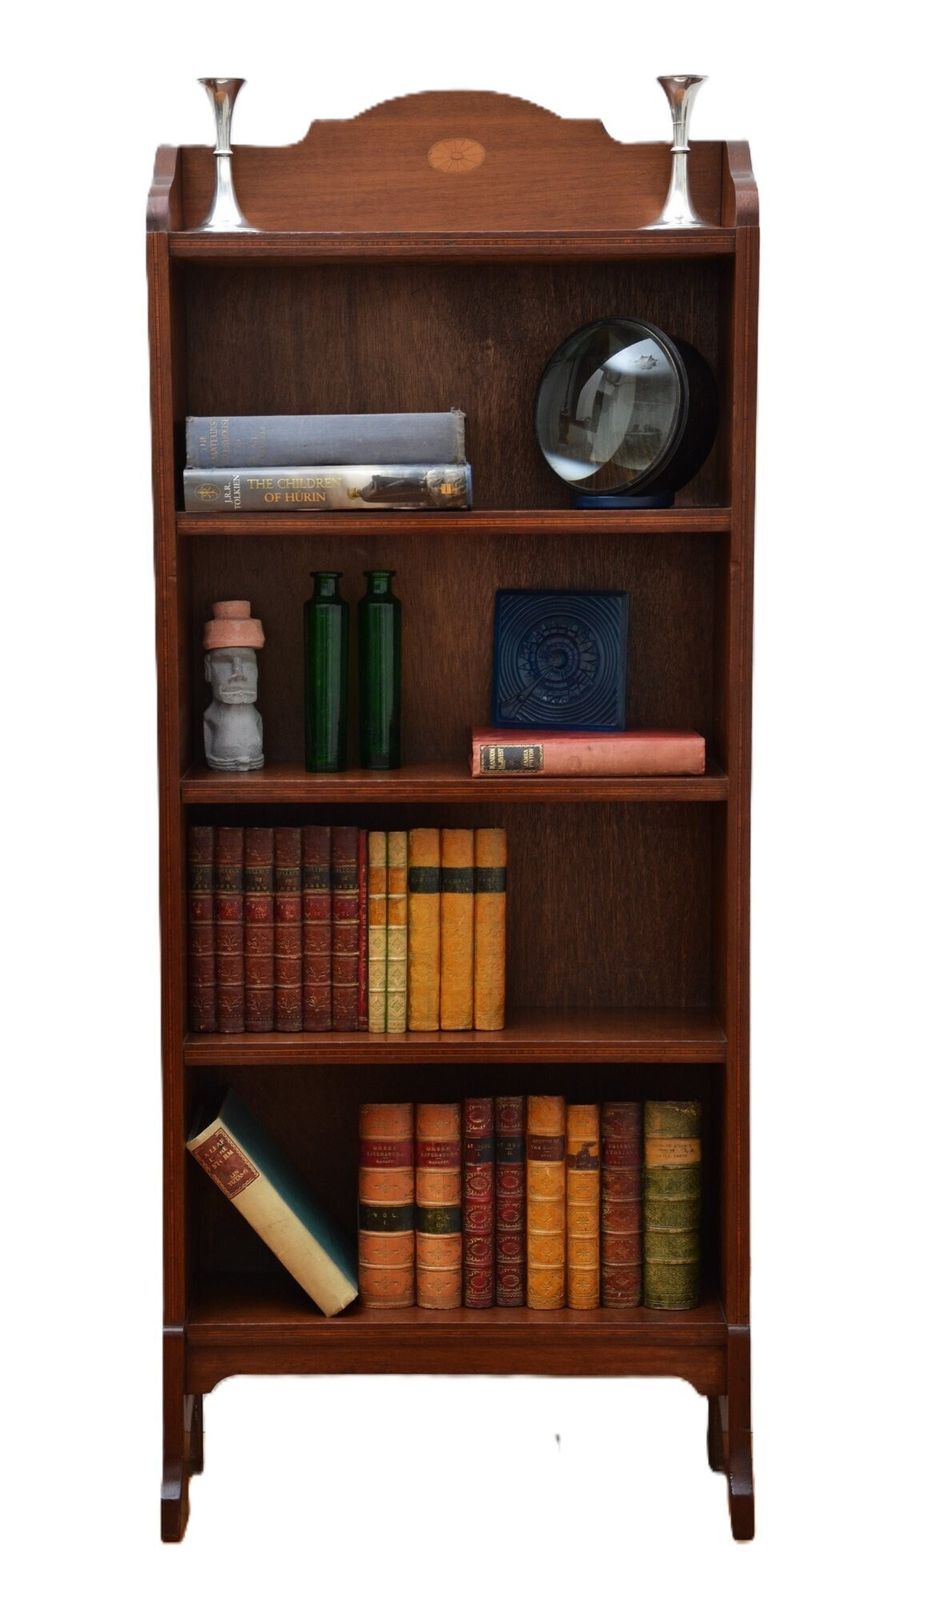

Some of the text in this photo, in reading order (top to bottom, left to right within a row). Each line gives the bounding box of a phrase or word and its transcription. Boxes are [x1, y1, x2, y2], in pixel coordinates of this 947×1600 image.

[247, 478, 343, 489] THE CHILDREN
[232, 474, 241, 509] TOLKIEN
[264, 492, 282, 502] OF
